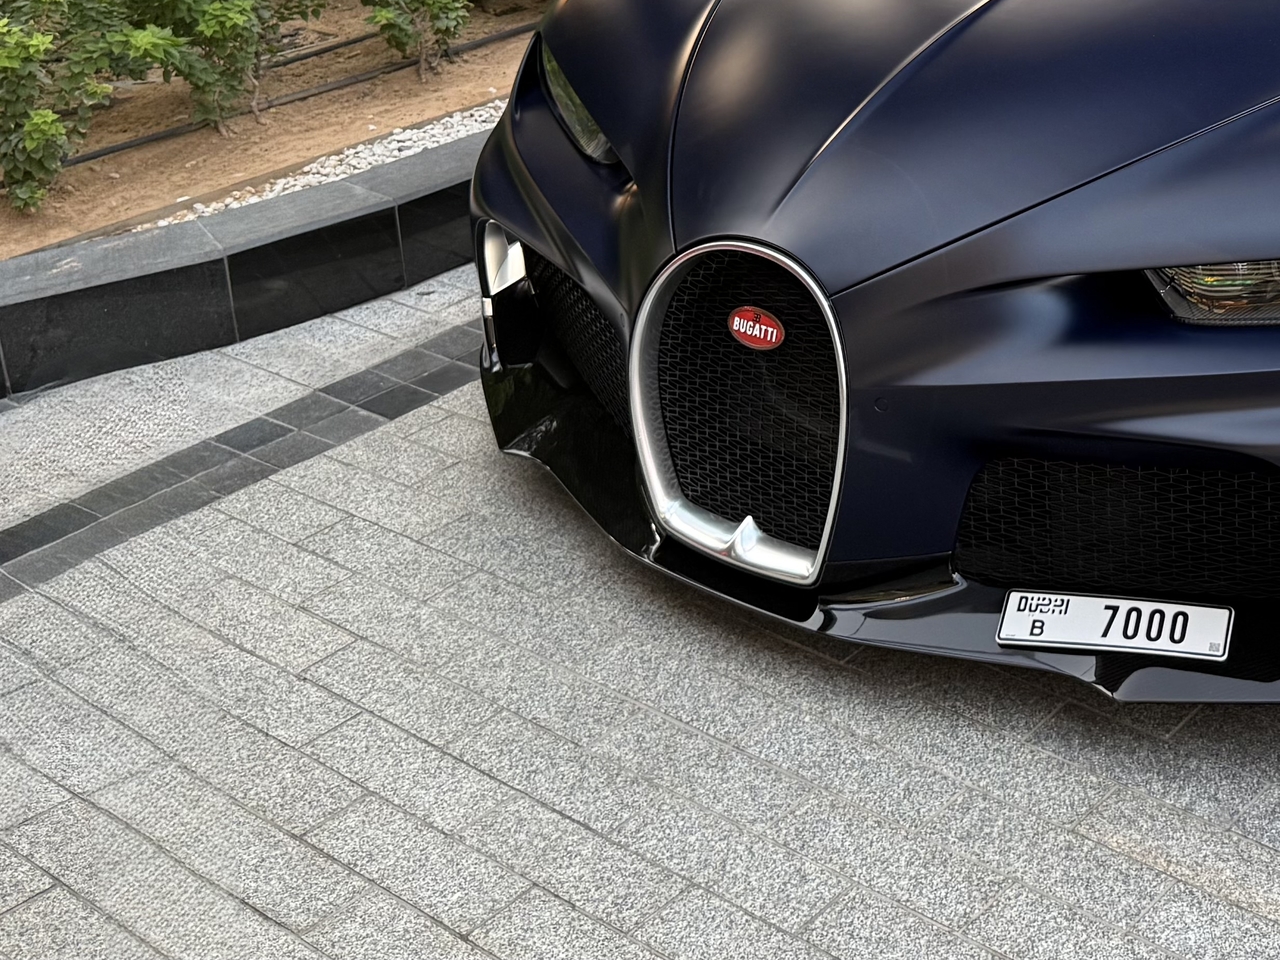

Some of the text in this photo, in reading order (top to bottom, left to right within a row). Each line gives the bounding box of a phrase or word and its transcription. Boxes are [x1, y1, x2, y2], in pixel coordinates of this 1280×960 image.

[733, 316, 777, 343] BUGATTI
[1029, 619, 1045, 637] B
[1100, 604, 1190, 645] 7000
